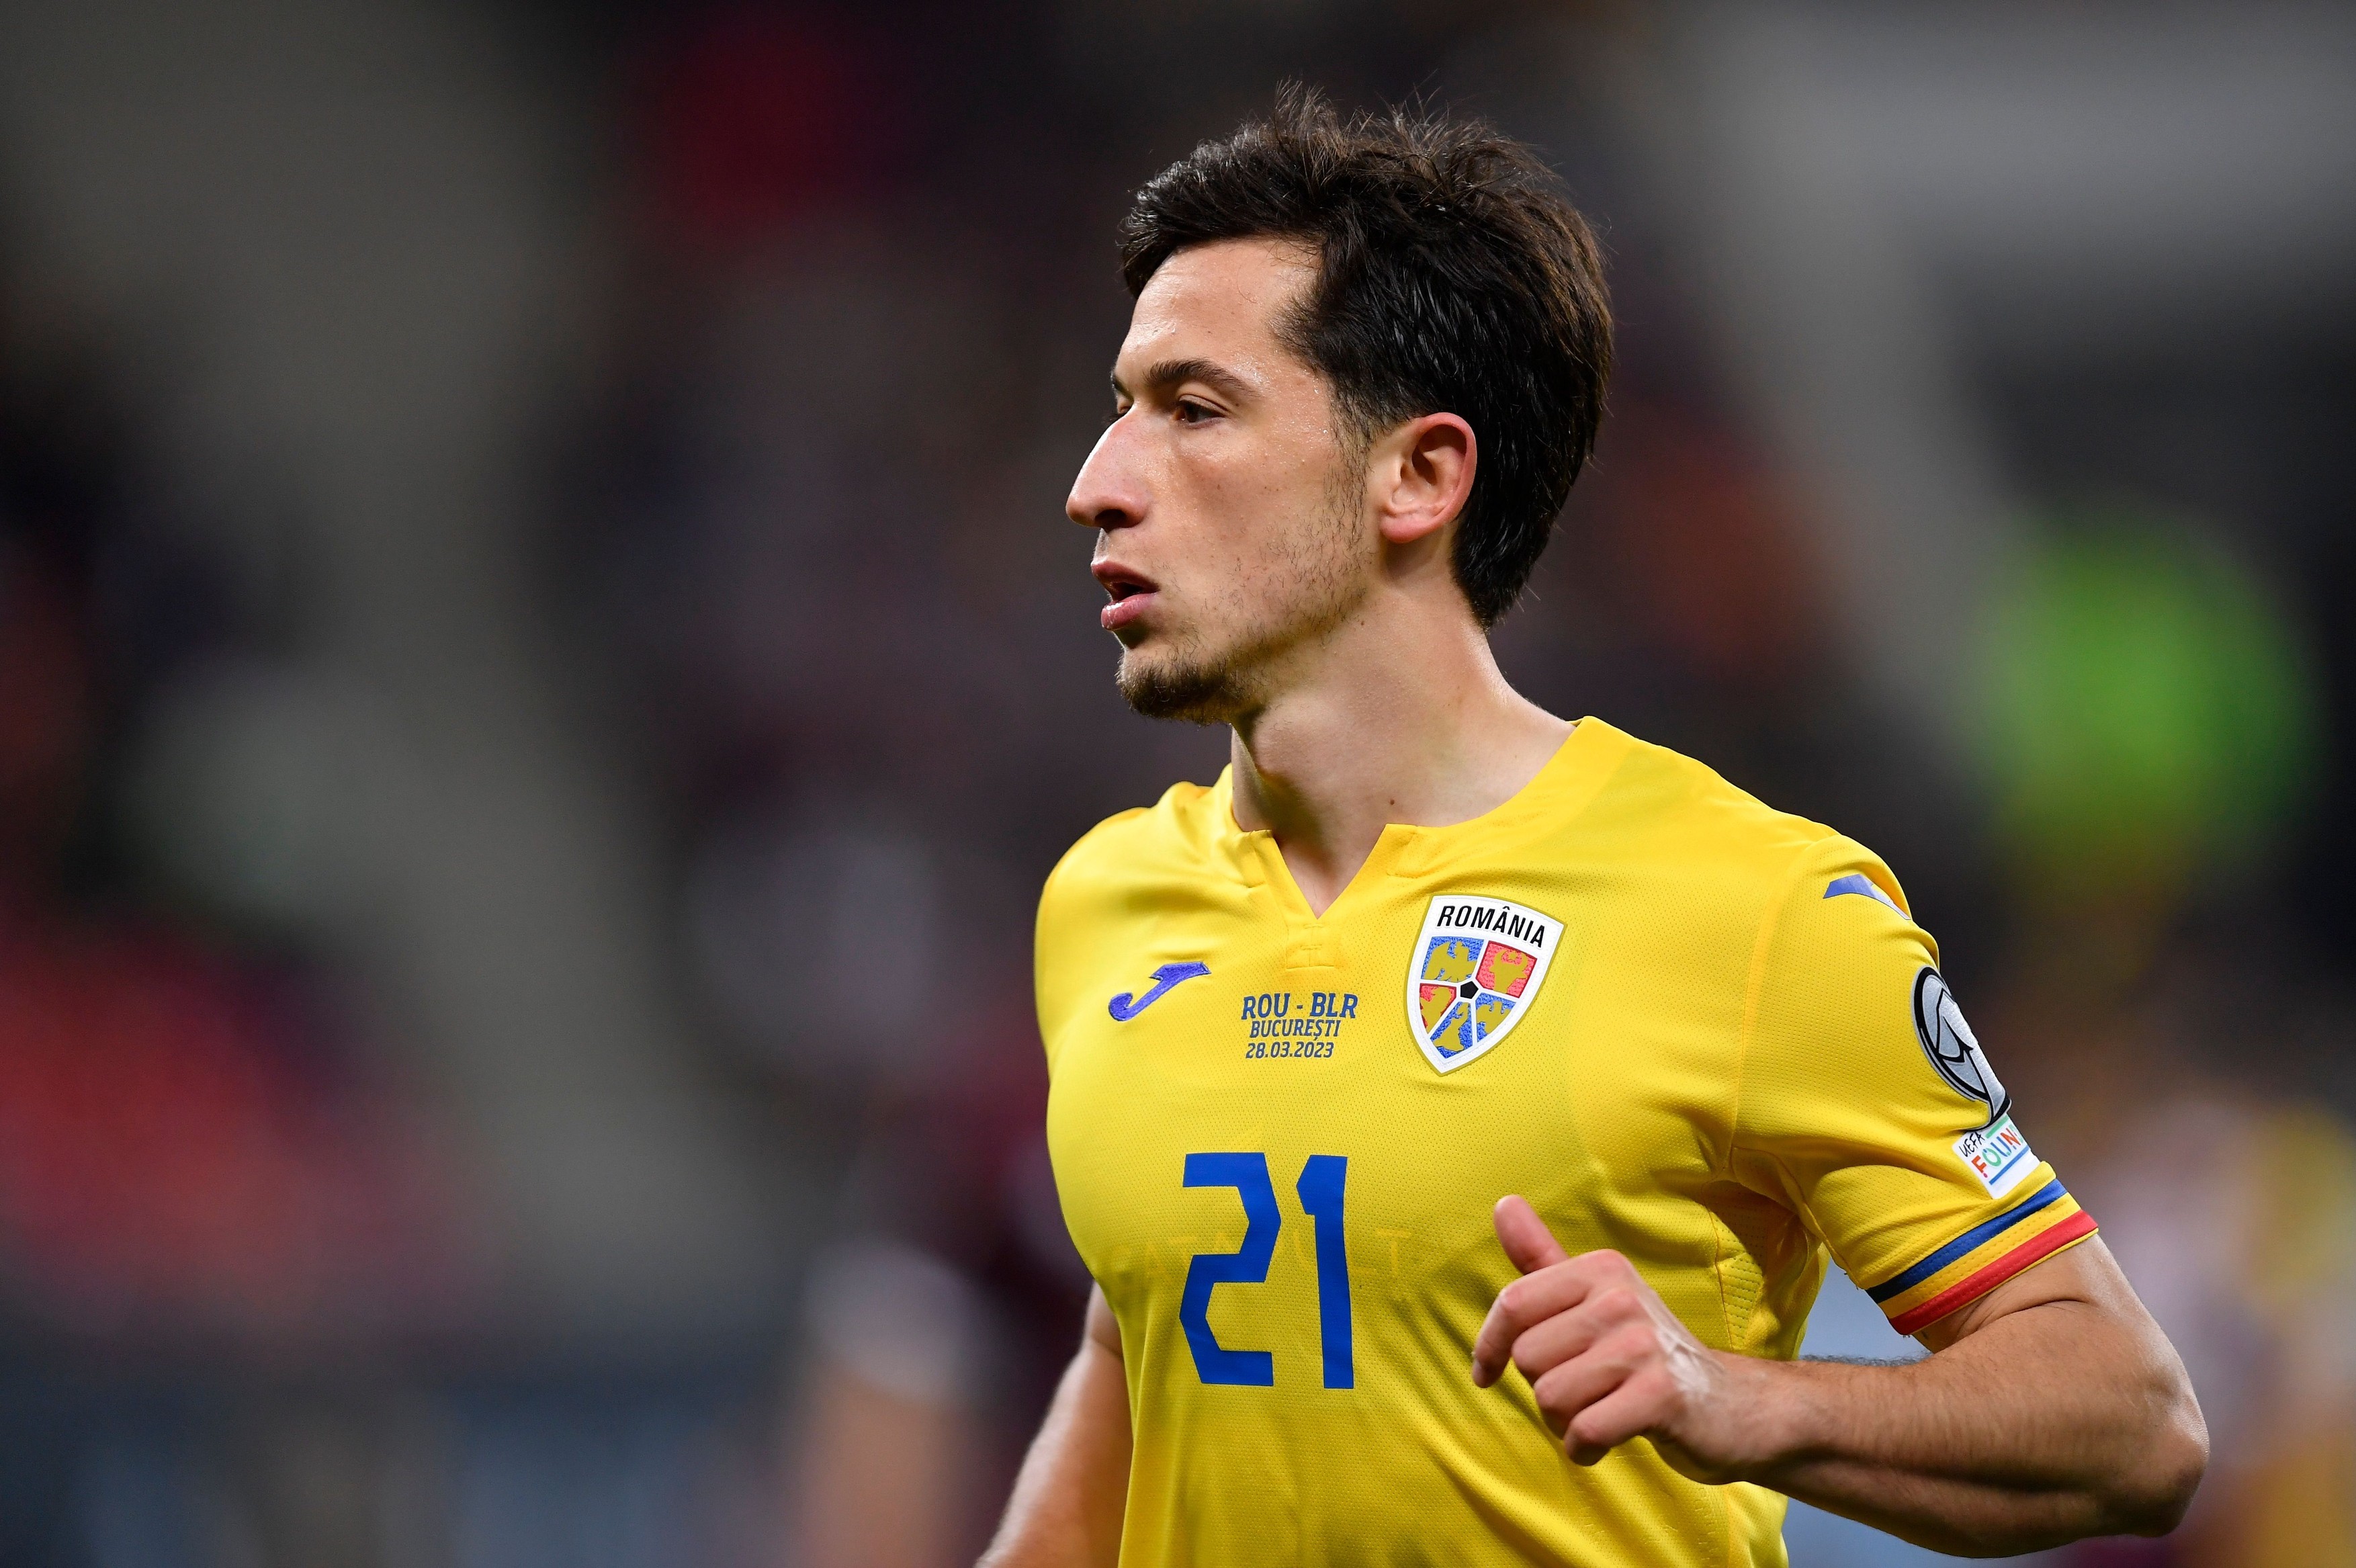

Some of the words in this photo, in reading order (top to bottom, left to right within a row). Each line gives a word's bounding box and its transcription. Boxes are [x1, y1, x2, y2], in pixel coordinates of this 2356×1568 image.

[1436, 905, 1545, 948] ROMÂNIA
[1241, 992, 1291, 1020] ROU
[1310, 992, 1358, 1018] BLR
[1246, 1041, 1334, 1059] 28.03.2023
[1958, 1131, 1986, 1158] UEFA
[1179, 1151, 1354, 1389] 21
